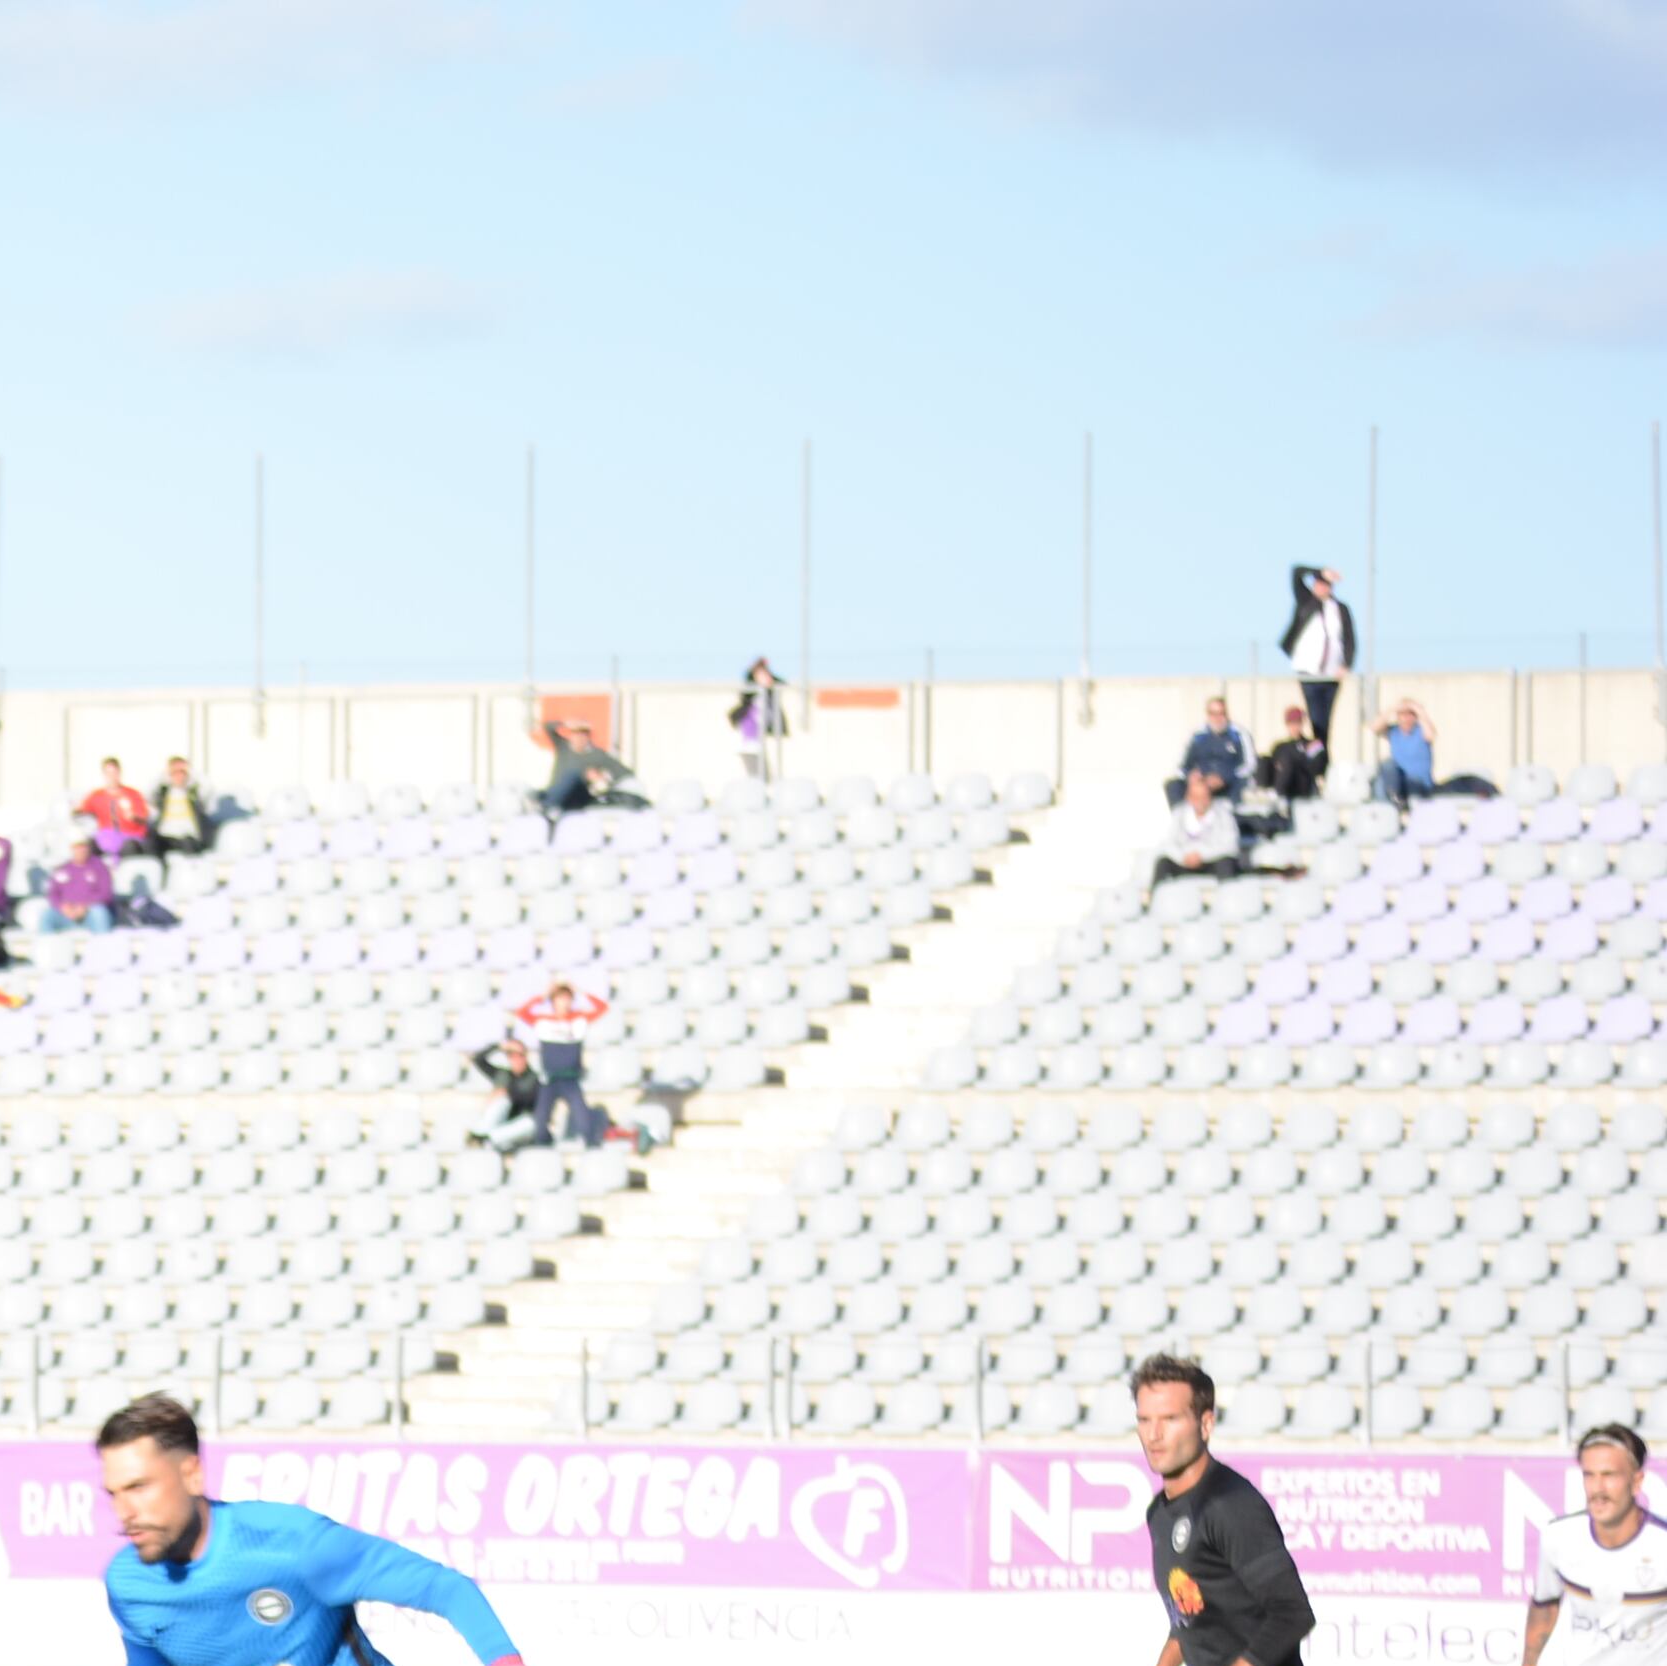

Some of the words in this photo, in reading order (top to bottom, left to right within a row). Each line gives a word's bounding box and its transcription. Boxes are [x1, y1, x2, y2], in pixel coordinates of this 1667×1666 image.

[503, 1452, 780, 1542] ORTEGA
[1261, 1467, 1396, 1497] EXPERTOS
[1401, 1468, 1441, 1498] EN
[20, 1481, 94, 1538] BAR
[989, 1460, 1154, 1566] NP
[1340, 1524, 1492, 1553] DEPORTIVA
[988, 1566, 1153, 1591] NUTRITION
